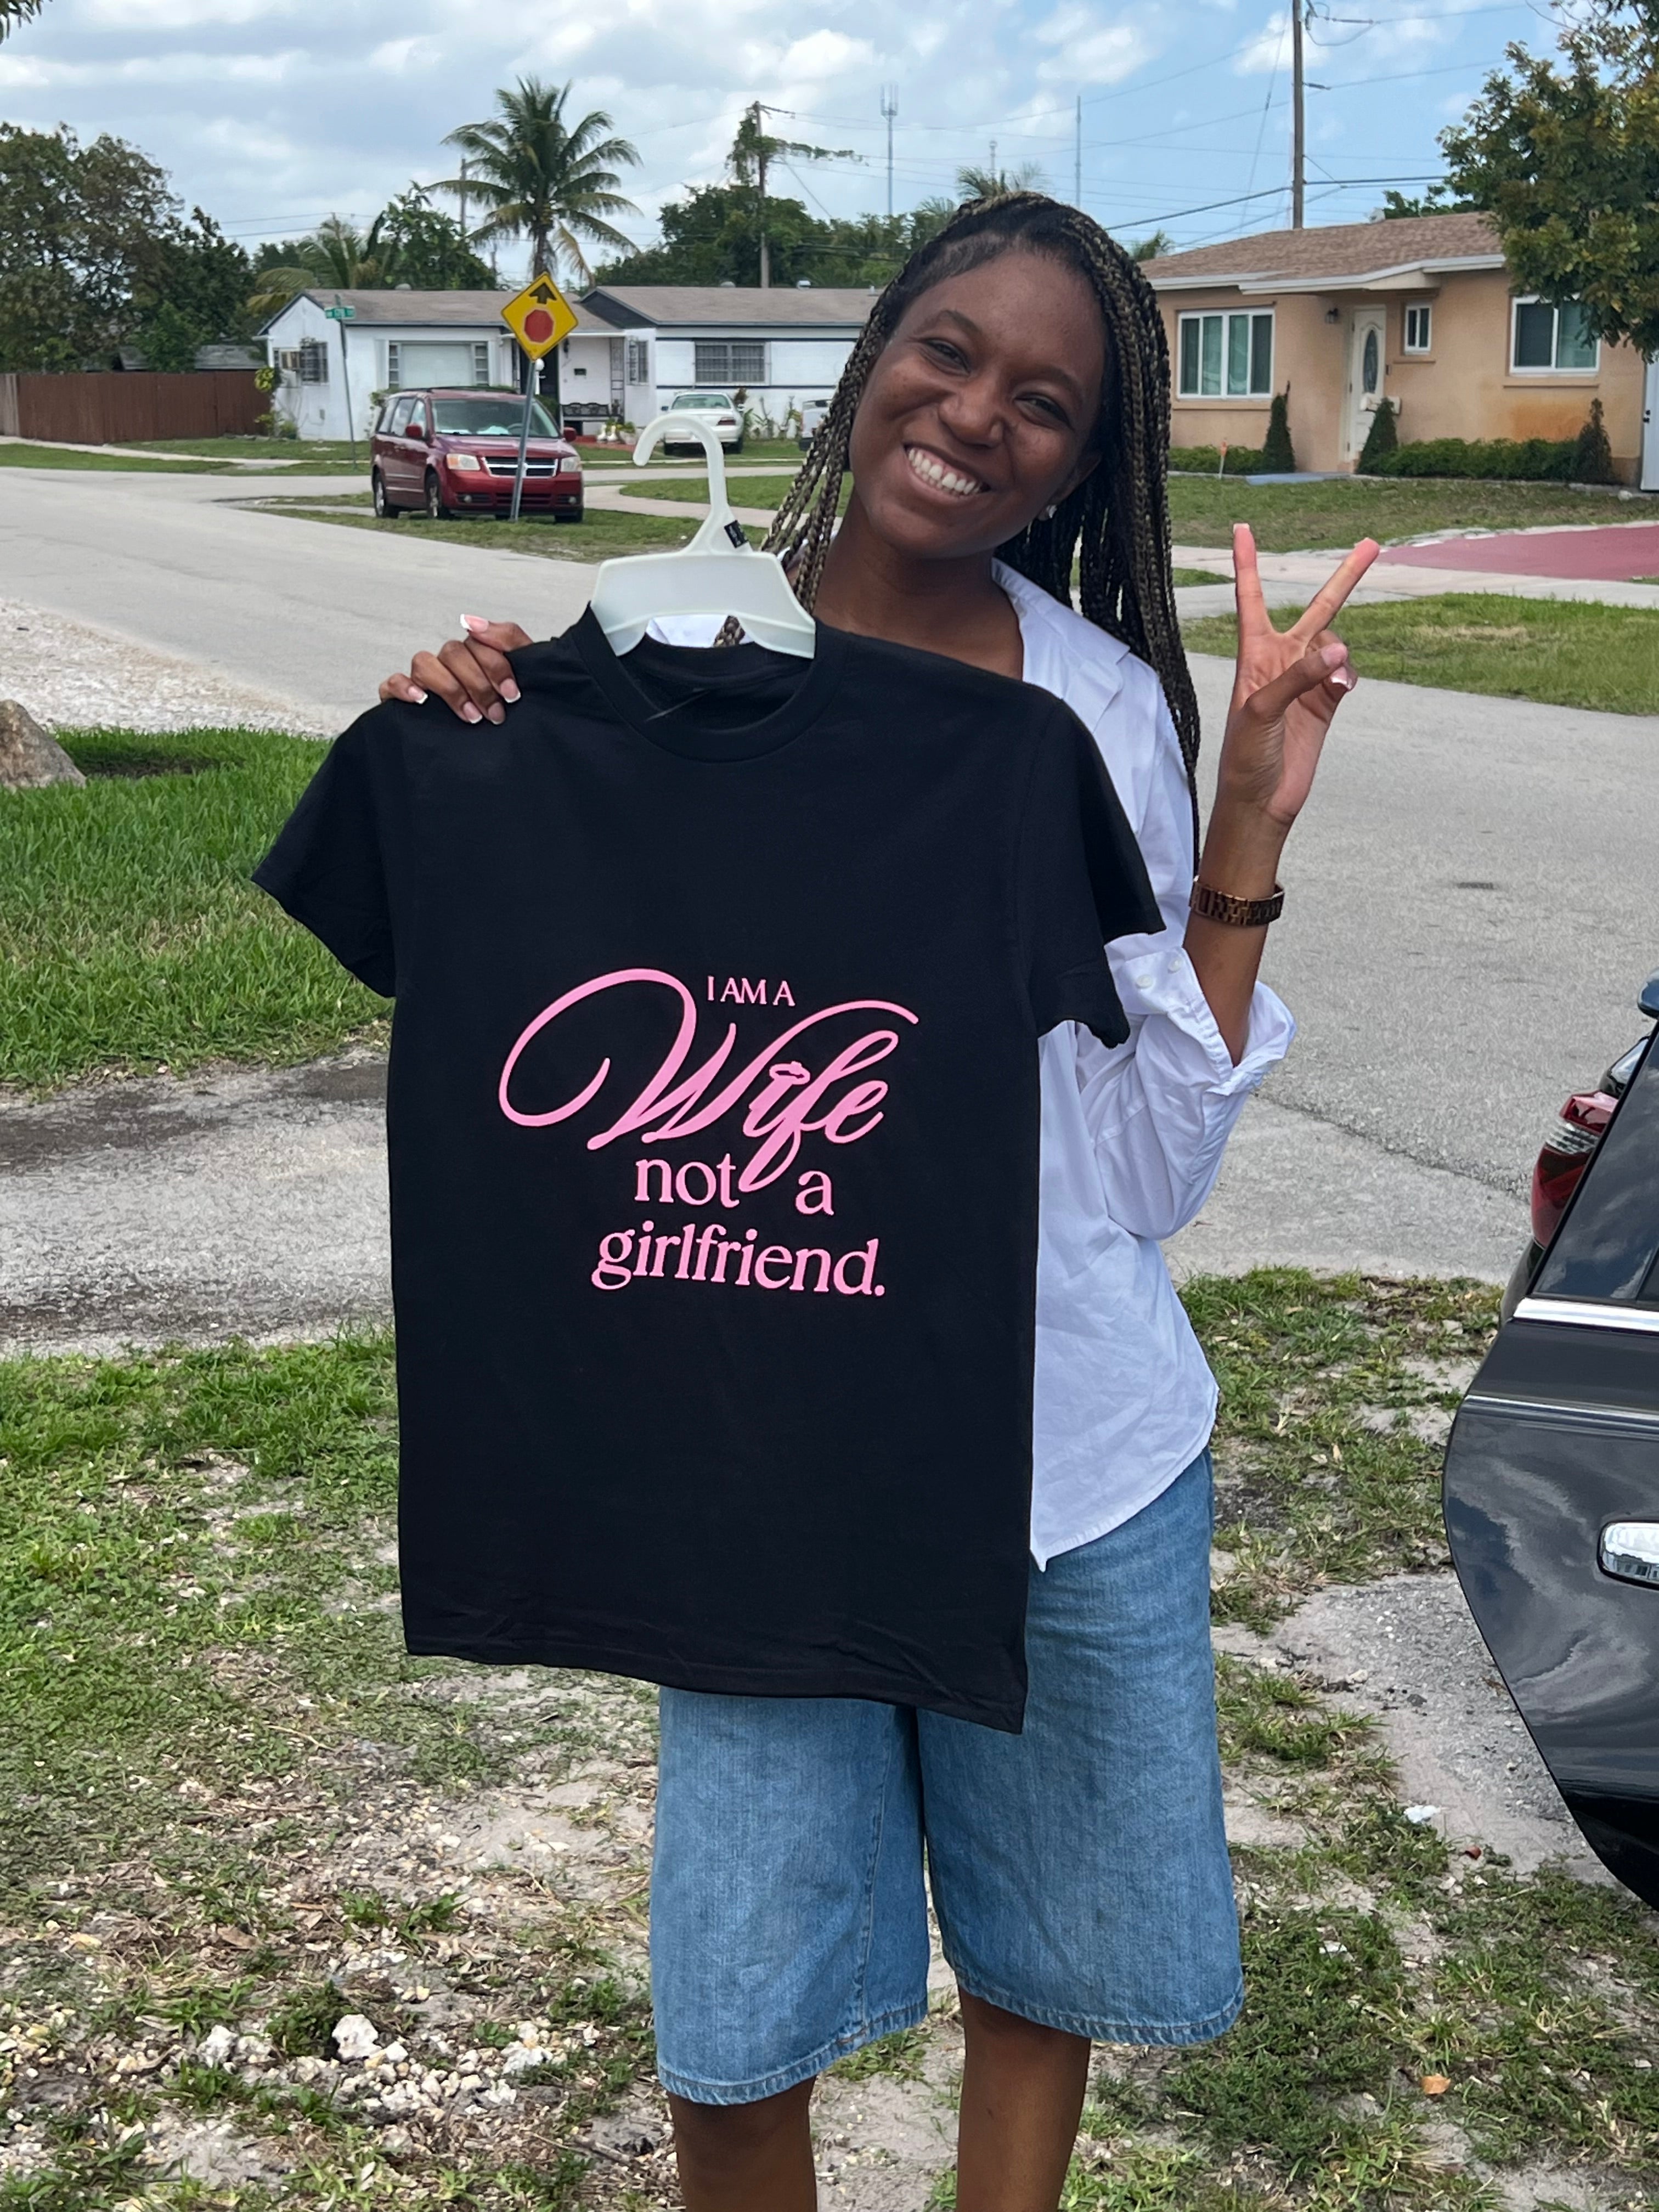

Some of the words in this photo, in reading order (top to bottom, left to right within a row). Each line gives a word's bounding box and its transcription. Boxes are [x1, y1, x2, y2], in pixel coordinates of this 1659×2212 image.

[707, 975, 715, 1001] I
[720, 977, 768, 1005] AM
[773, 980, 795, 1007] A
[498, 968, 919, 1193] Wife
[634, 1154, 740, 1209] not
[795, 1170, 835, 1216] a
[591, 1220, 885, 1297] girlfriend.
